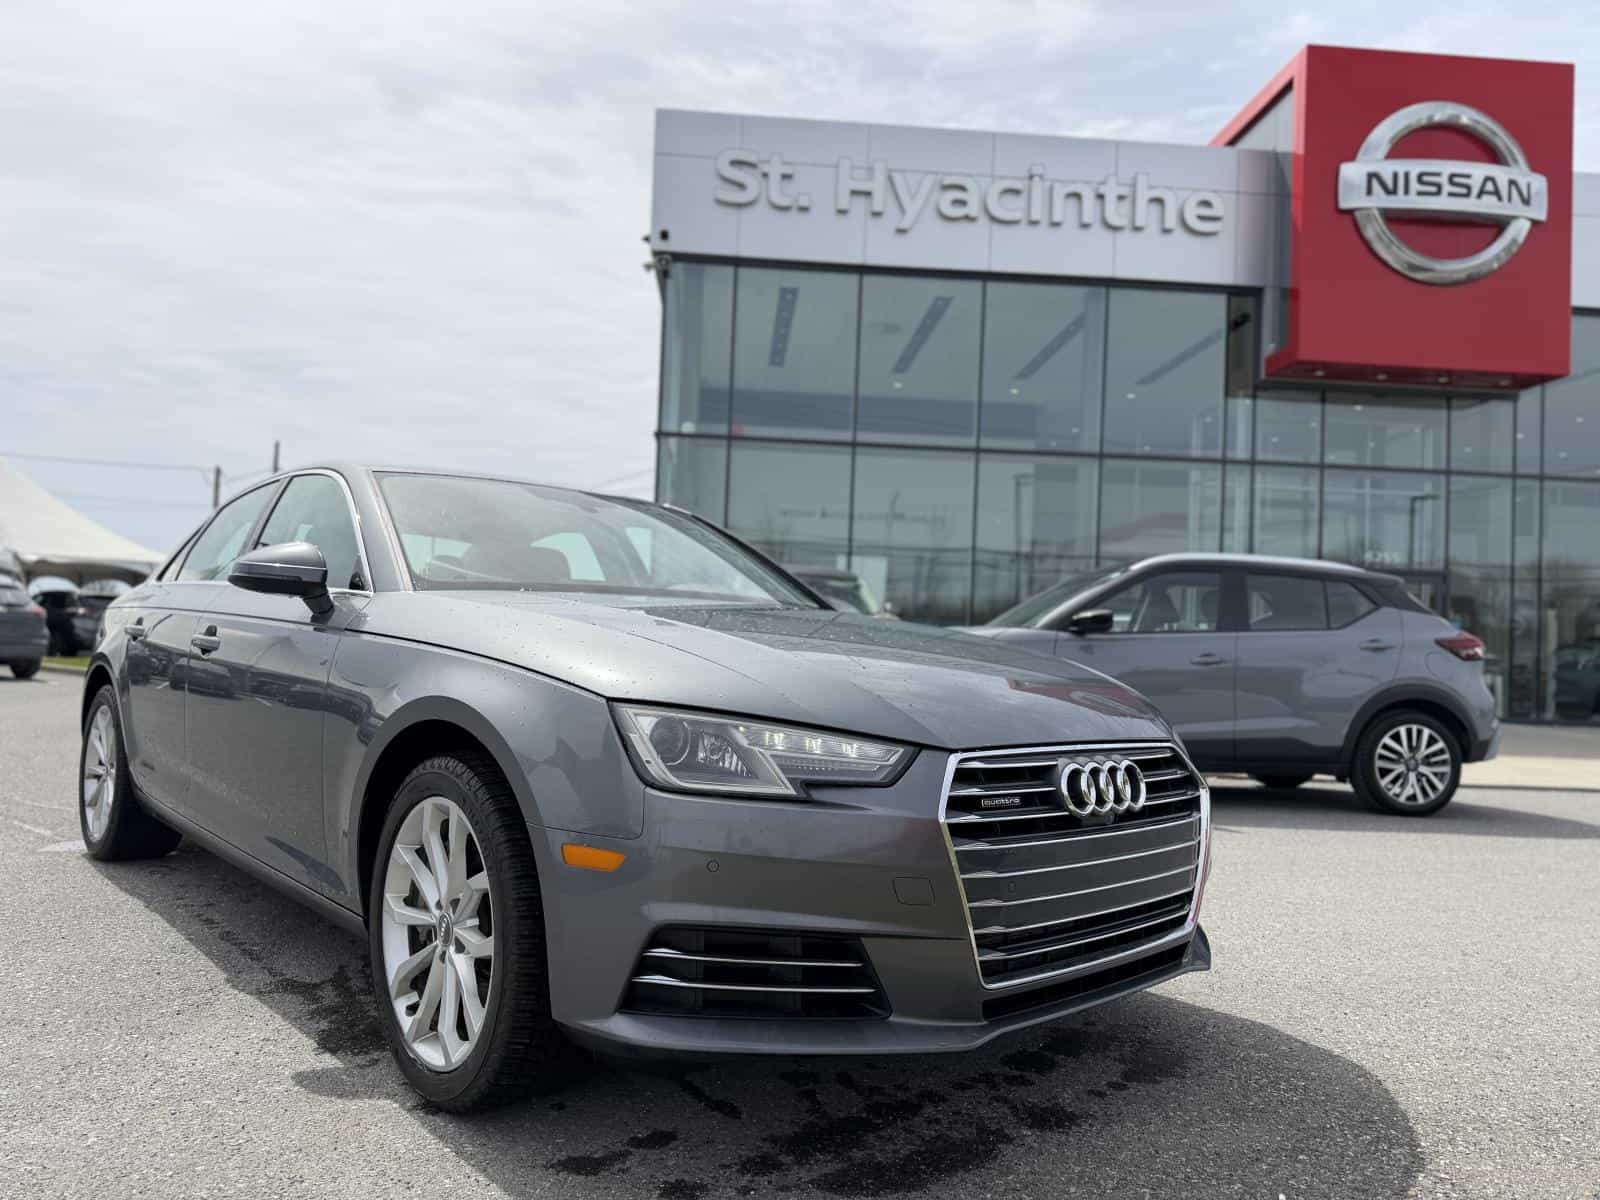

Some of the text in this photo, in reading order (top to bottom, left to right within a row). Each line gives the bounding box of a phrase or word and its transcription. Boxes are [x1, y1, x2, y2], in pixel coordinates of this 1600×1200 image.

[714, 148, 1225, 236] St. Hyacinthe
[1365, 170, 1532, 207] NISSAN
